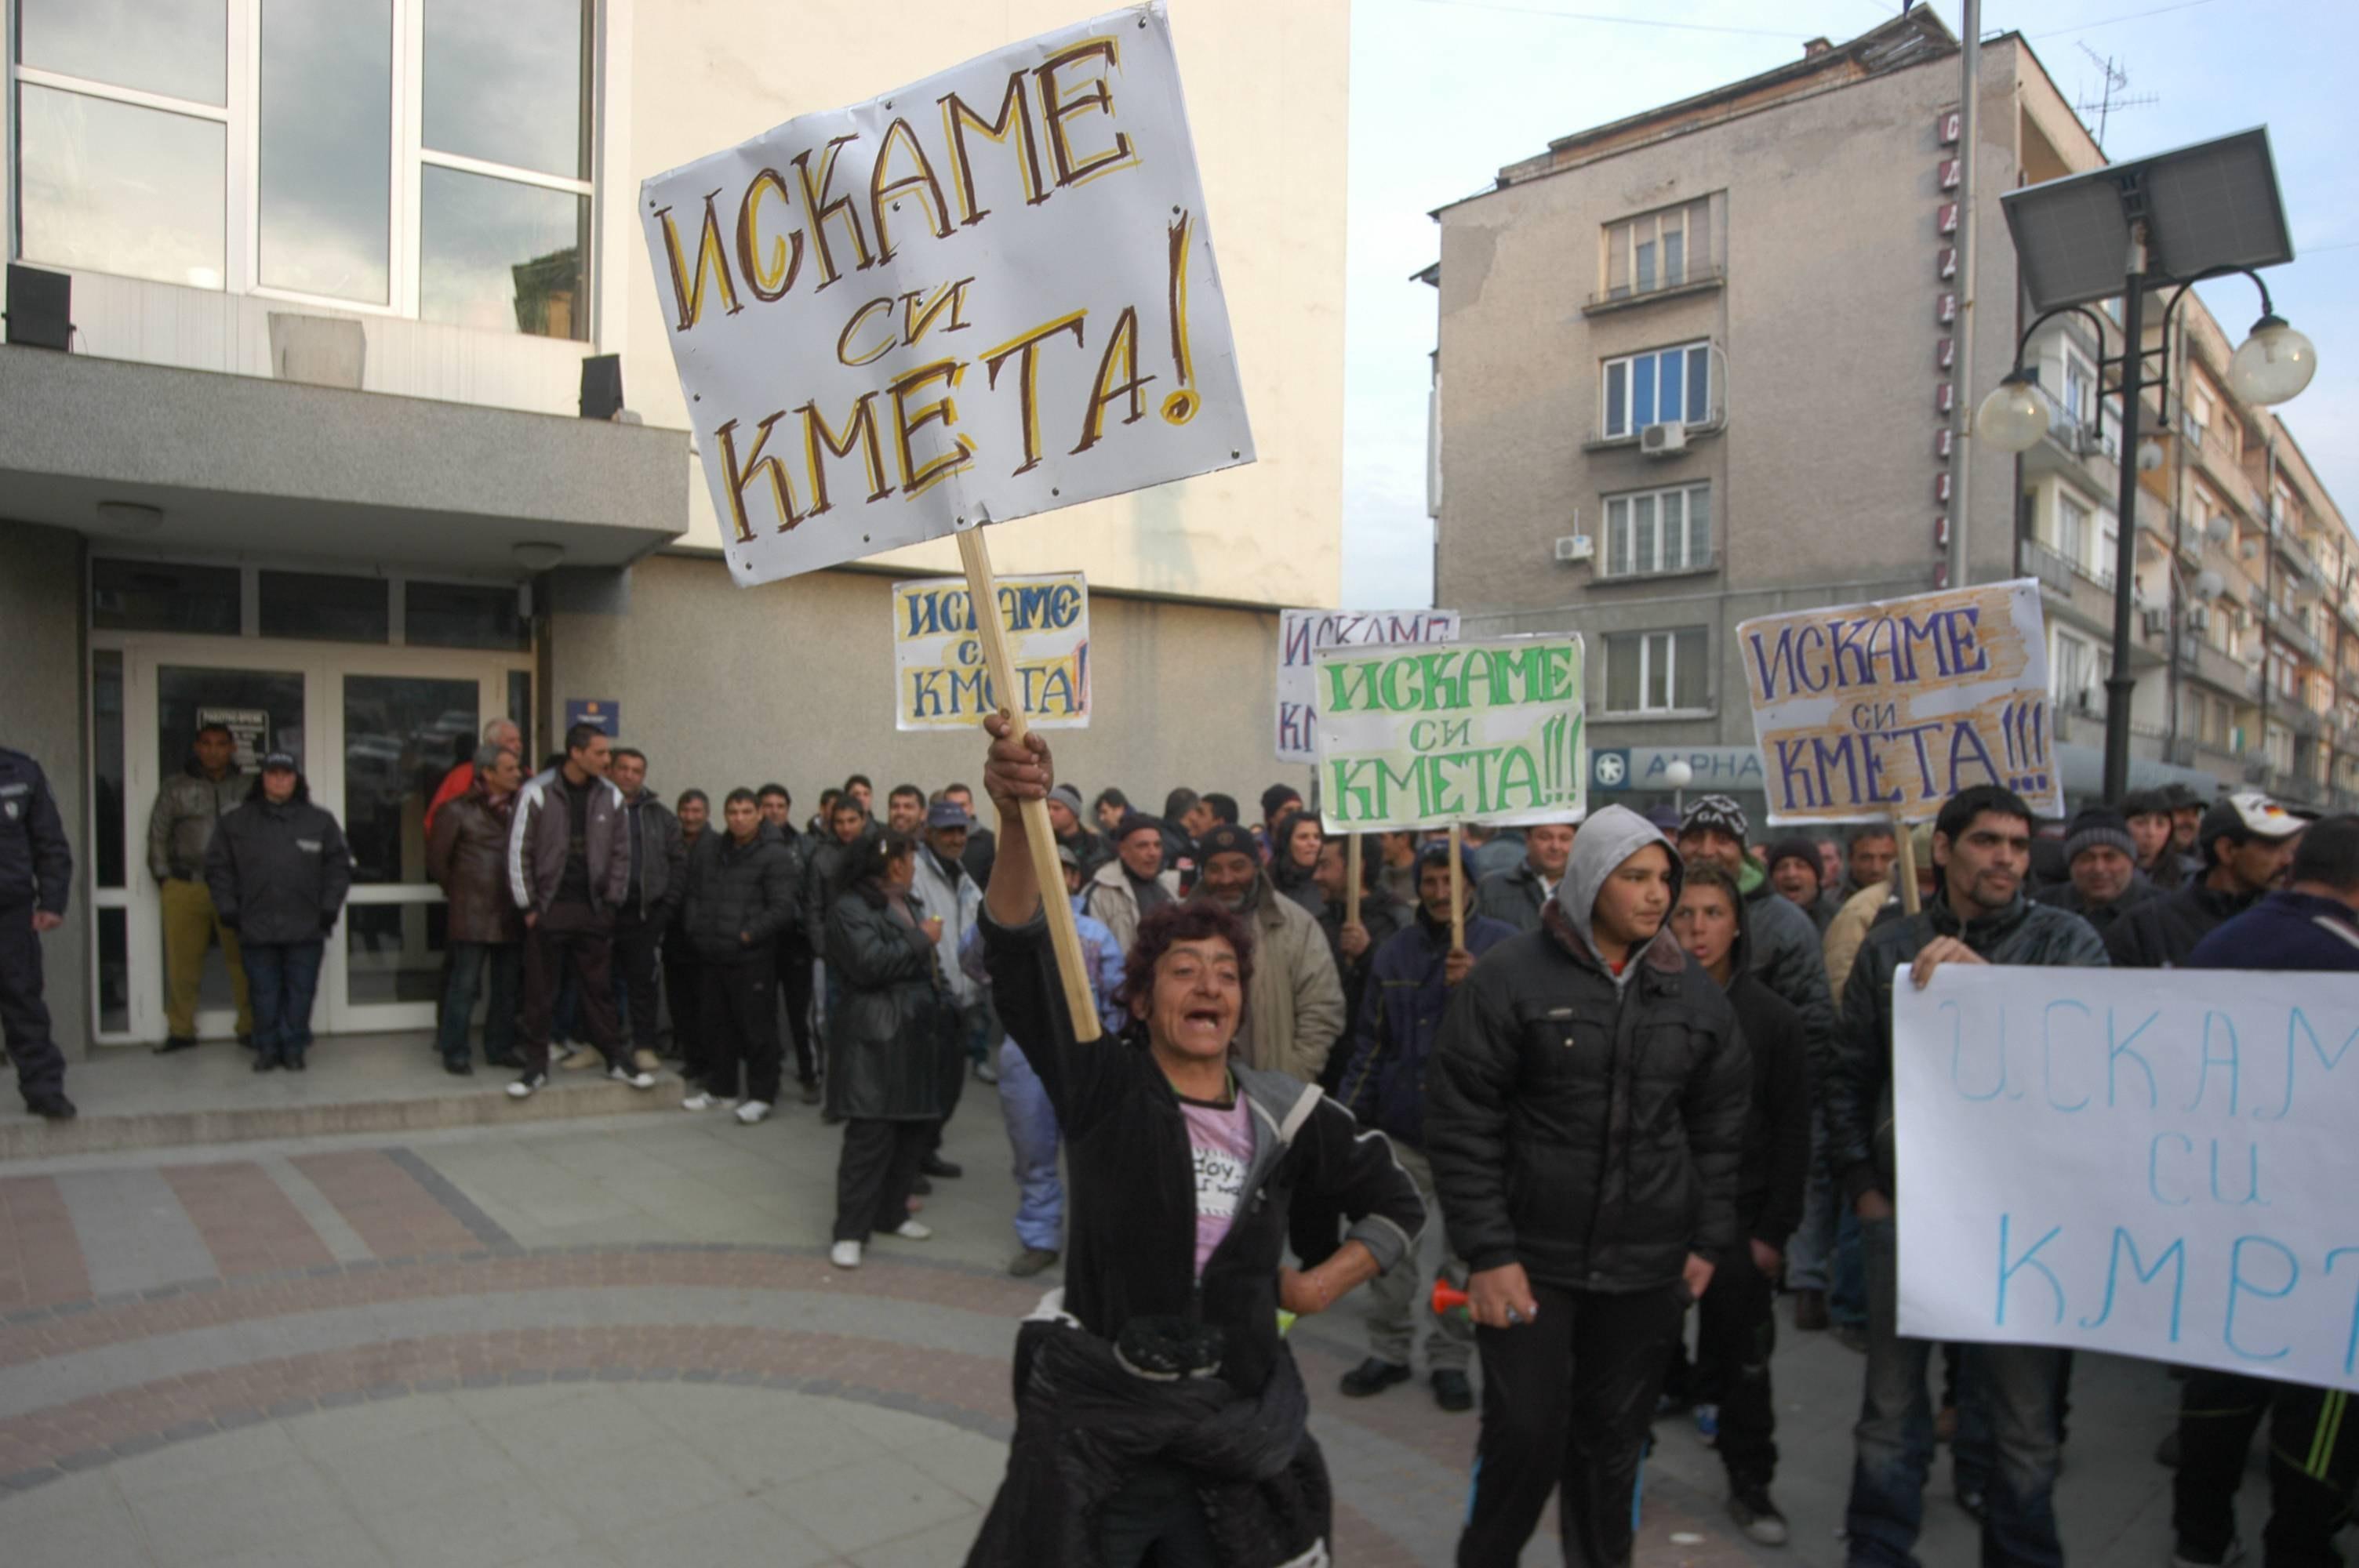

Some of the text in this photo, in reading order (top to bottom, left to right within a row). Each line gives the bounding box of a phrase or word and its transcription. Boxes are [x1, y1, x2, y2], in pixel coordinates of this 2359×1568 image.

[653, 36, 1141, 330] ИСКАМЕ
[714, 209, 1200, 543] КМЕТА!
[1323, 645, 1572, 712] ИСКАМЕ
[1750, 607, 1986, 700] ИСКАМЕ
[1330, 712, 1582, 821] КМЕТА!!!
[1645, 753, 1763, 777] APHA
[1775, 702, 2048, 810] КМЕТА!!!
